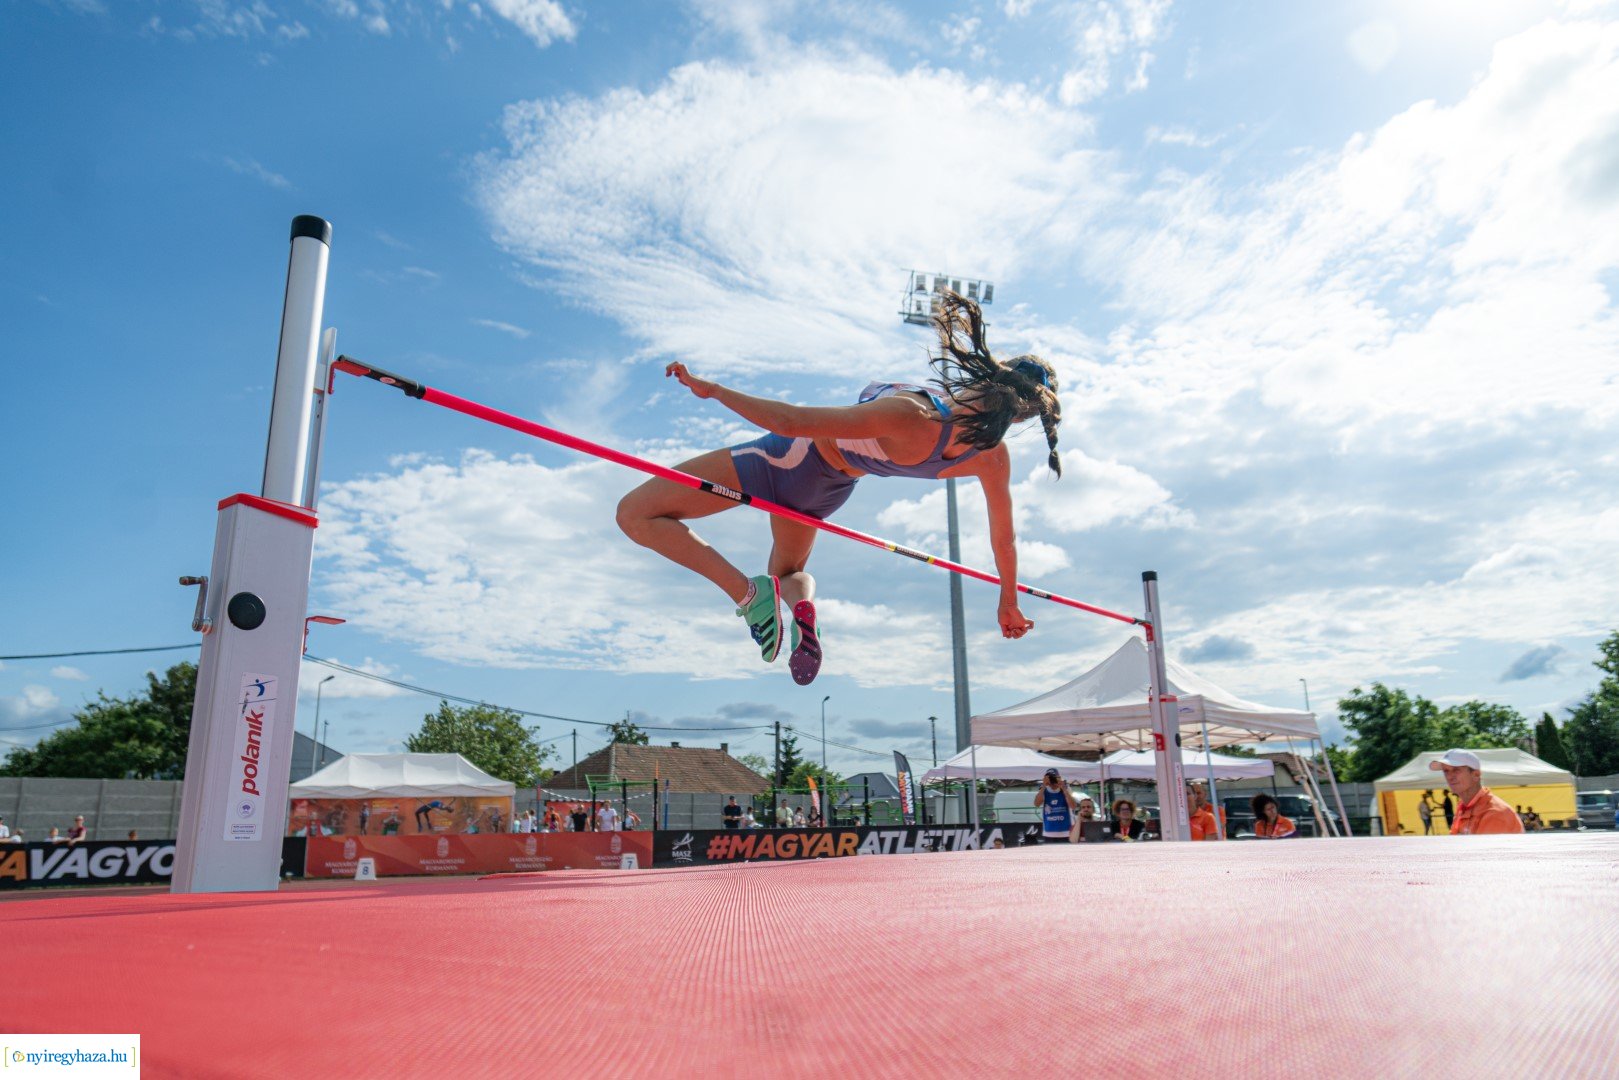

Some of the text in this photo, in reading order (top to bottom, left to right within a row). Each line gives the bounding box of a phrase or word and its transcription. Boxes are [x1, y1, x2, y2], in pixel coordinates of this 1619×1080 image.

[240, 708, 264, 796] polanik
[672, 850, 692, 858] MASZ
[627, 860, 634, 869] 7
[362, 866, 369, 875] 8
